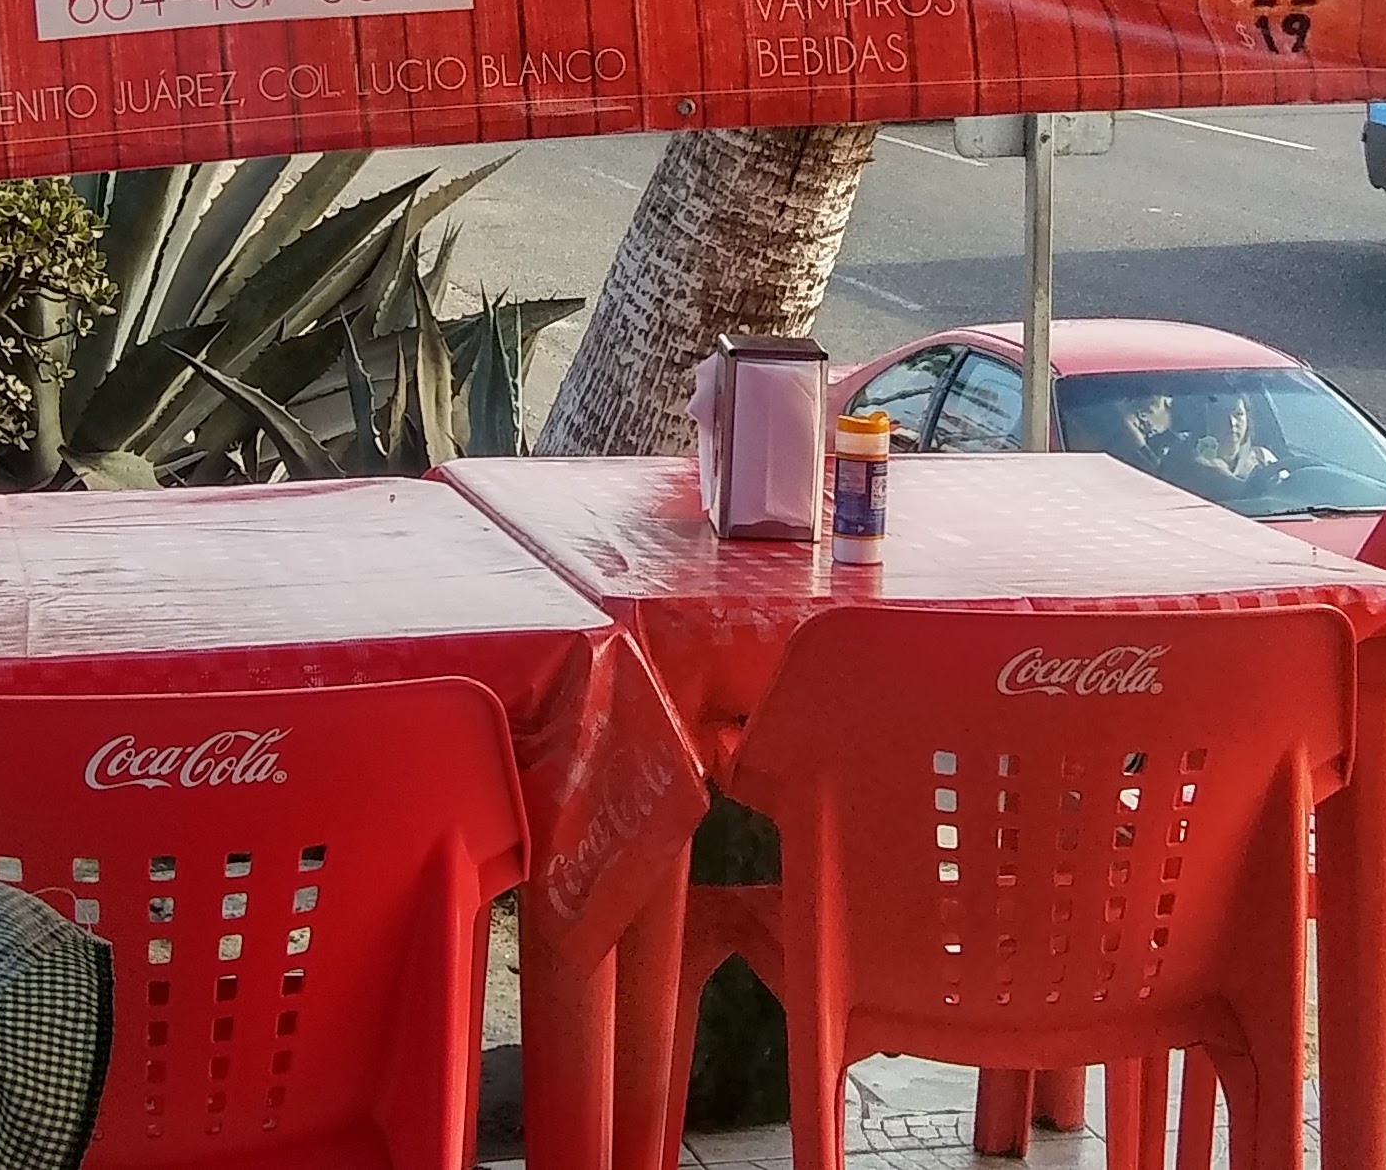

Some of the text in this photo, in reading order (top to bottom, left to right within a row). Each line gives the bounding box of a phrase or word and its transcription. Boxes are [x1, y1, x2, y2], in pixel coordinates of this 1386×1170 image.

[113, 69, 247, 116] JUÁREZ,
[258, 63, 347, 102] COL.
[353, 56, 468, 97] LUCIO
[481, 48, 627, 89] BLANCO
[756, 33, 909, 78] BEBIDAS
